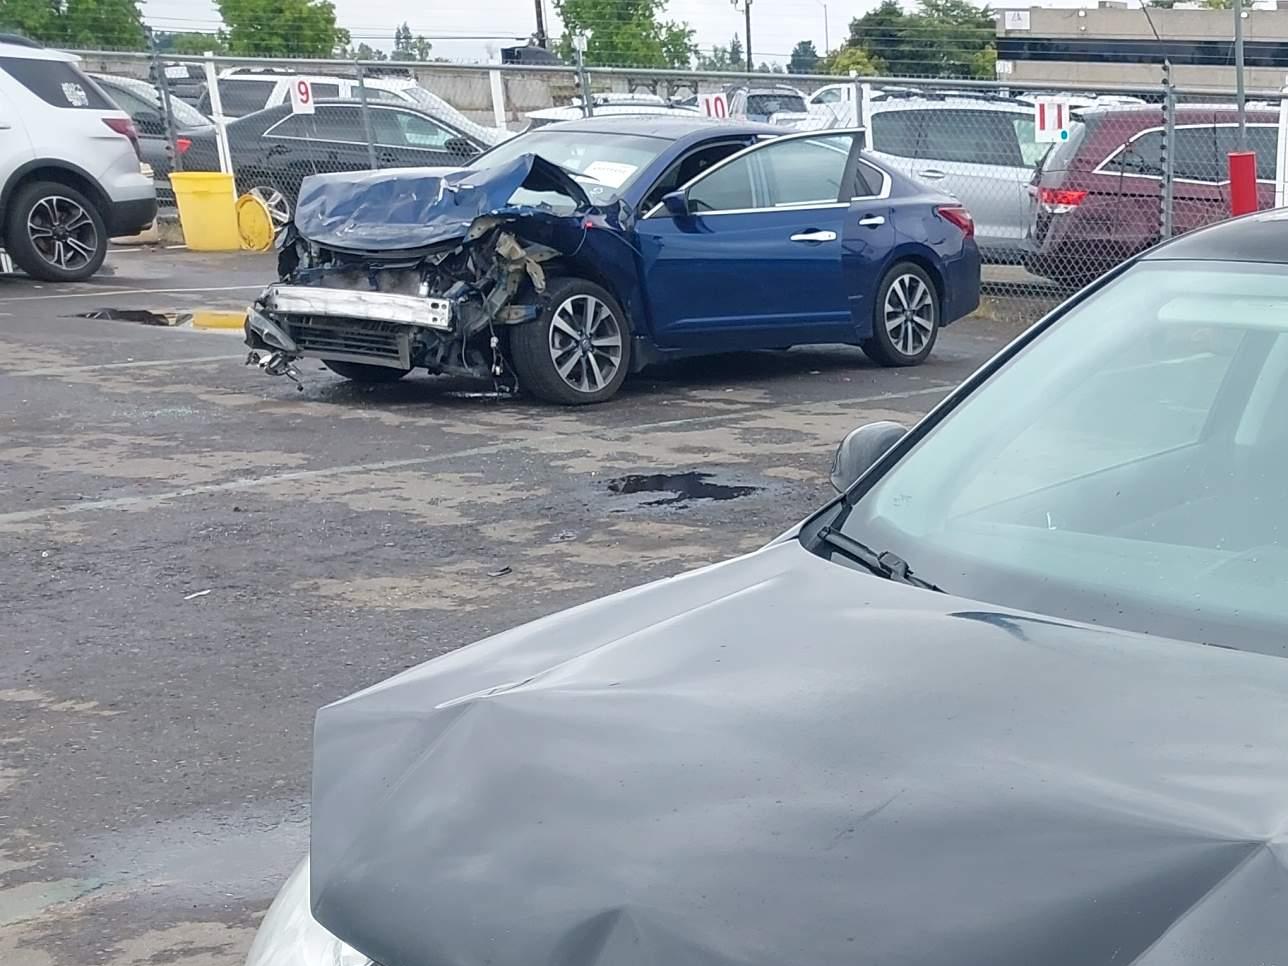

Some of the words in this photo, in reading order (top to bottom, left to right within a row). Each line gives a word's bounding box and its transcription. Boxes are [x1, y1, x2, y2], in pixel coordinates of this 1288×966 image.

[297, 80, 310, 104] 9
[705, 96, 726, 118] 10
[1039, 103, 1063, 130] 11
